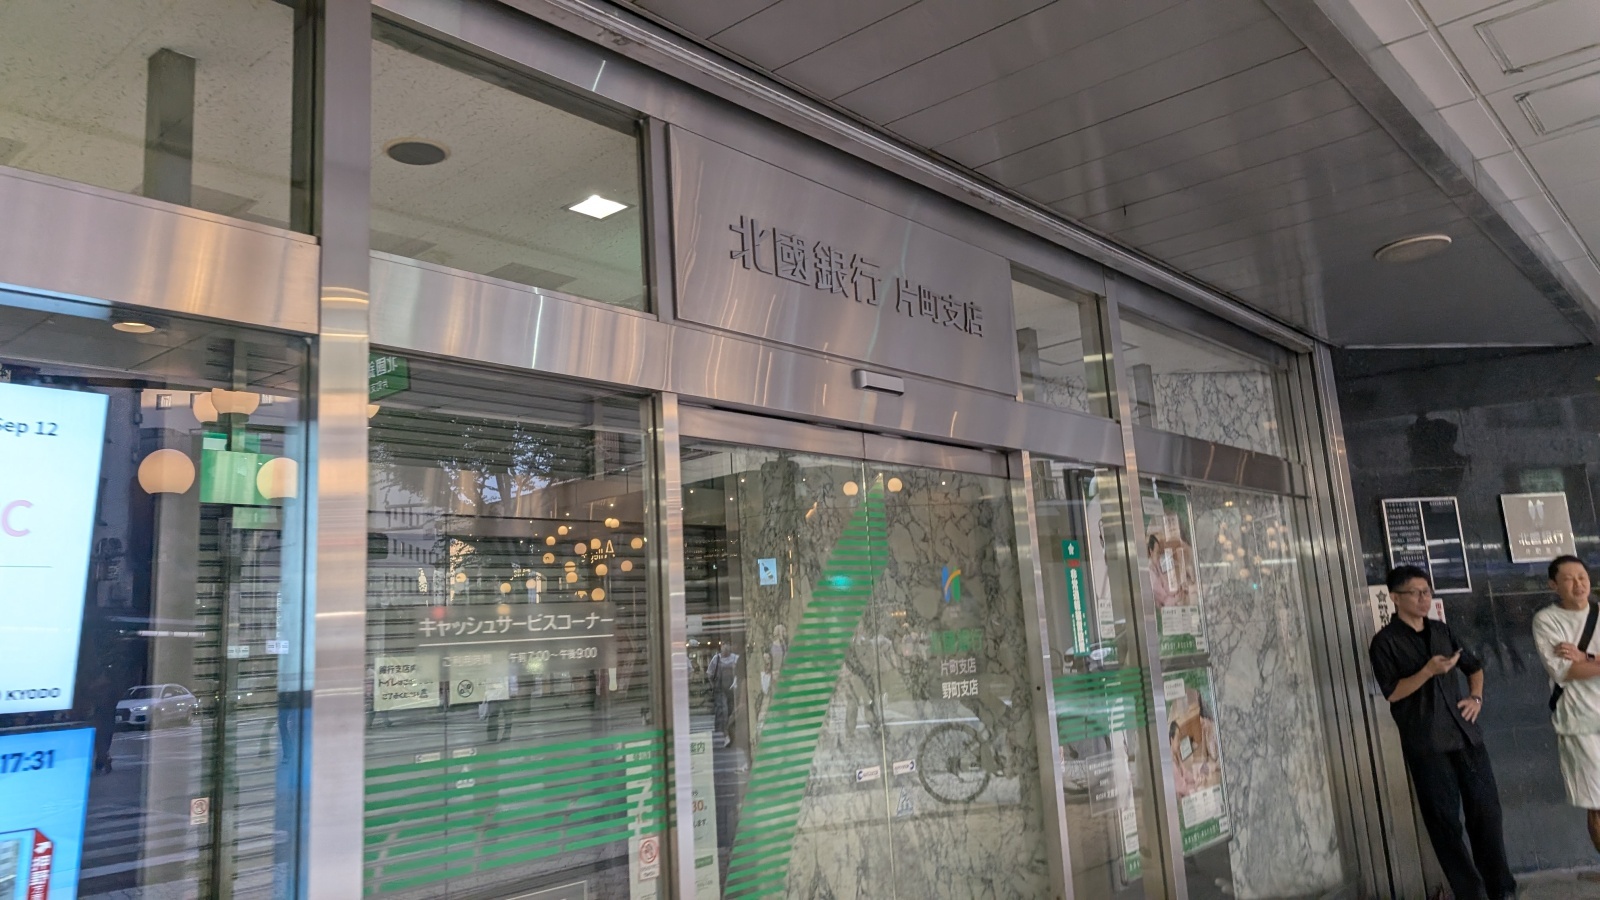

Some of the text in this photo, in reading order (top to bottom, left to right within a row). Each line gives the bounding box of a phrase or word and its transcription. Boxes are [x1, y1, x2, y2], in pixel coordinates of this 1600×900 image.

[729, 215, 983, 337] 北國銀行 片町支店
[34, 421, 59, 436] 12
[418, 612, 614, 637] キャッシュサービスコーナー
[941, 657, 977, 677] 片町支店
[941, 679, 979, 699] 野町支店
[0, 750, 56, 774] 17:31
